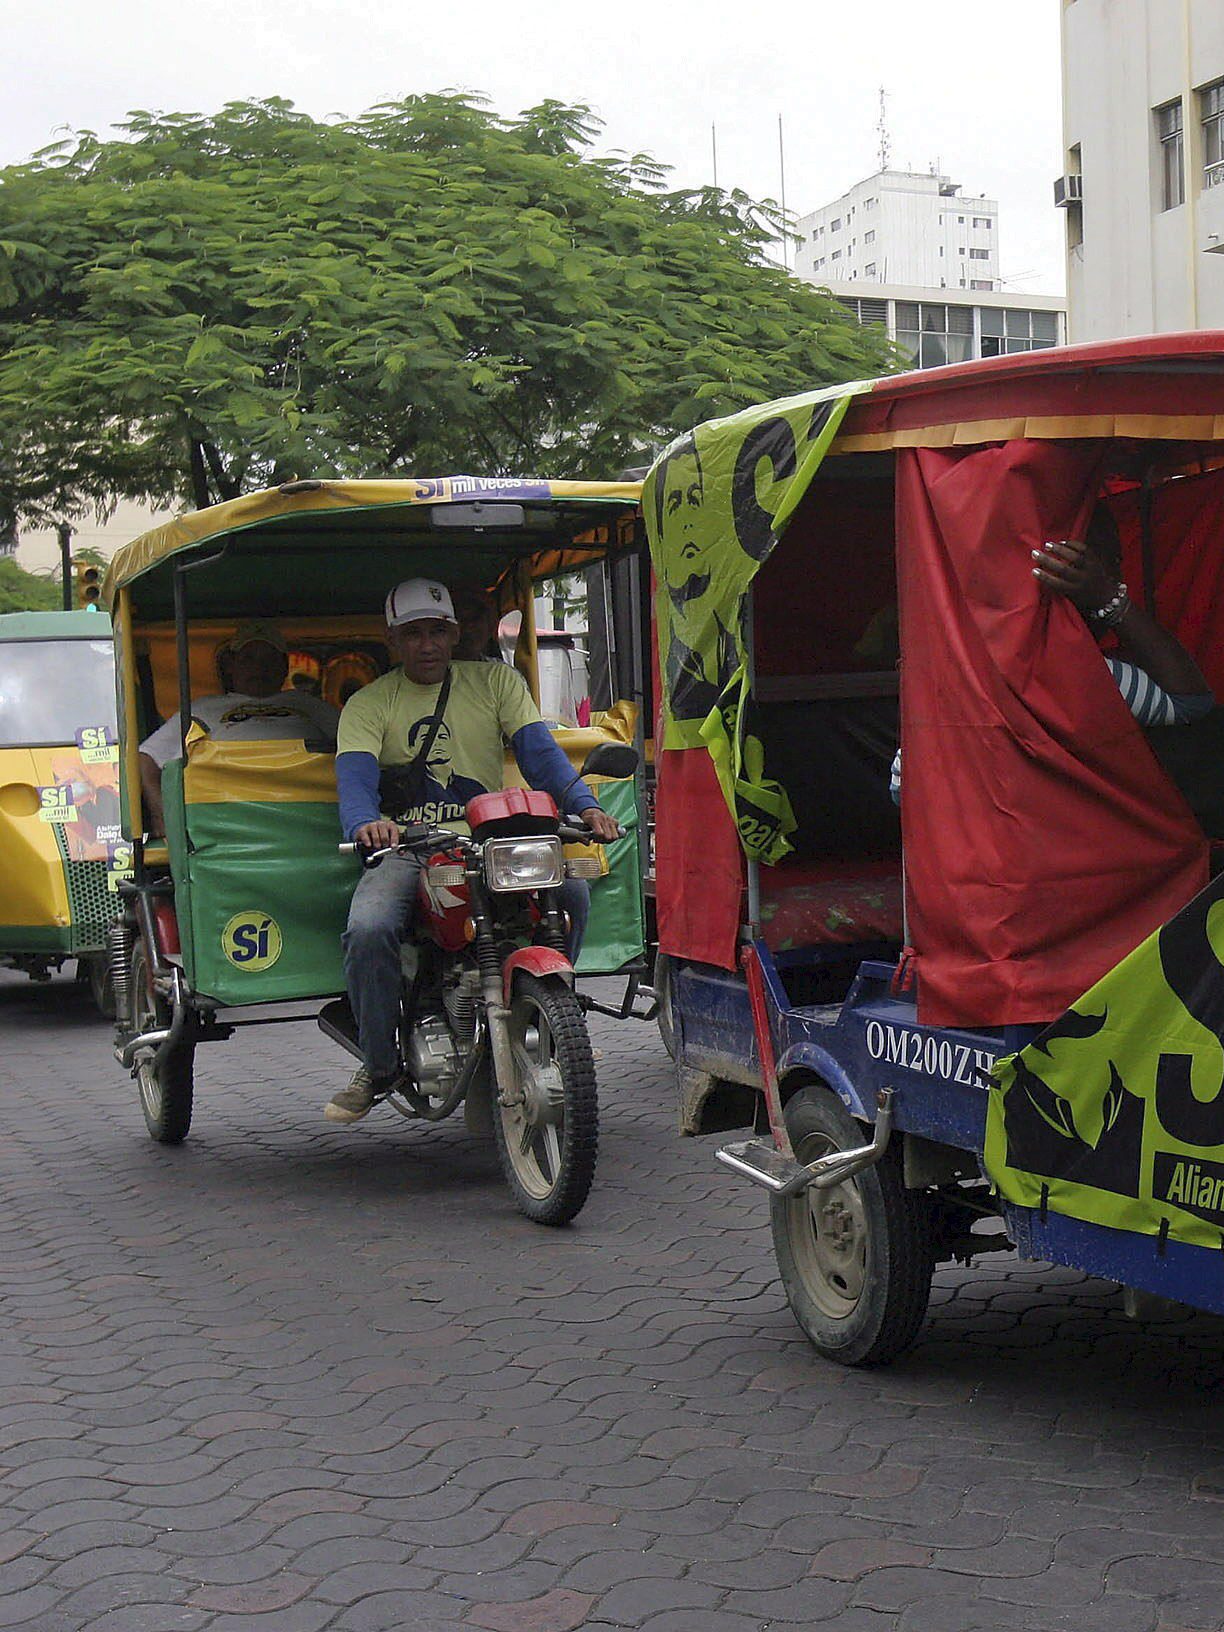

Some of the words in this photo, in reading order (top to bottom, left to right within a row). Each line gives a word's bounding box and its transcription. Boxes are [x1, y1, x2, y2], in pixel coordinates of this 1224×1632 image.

[452, 478, 476, 494] mil
[478, 477, 522, 491] veces
[81, 727, 107, 749] Sí
[41, 786, 67, 808] Sí
[232, 919, 272, 962] Sí
